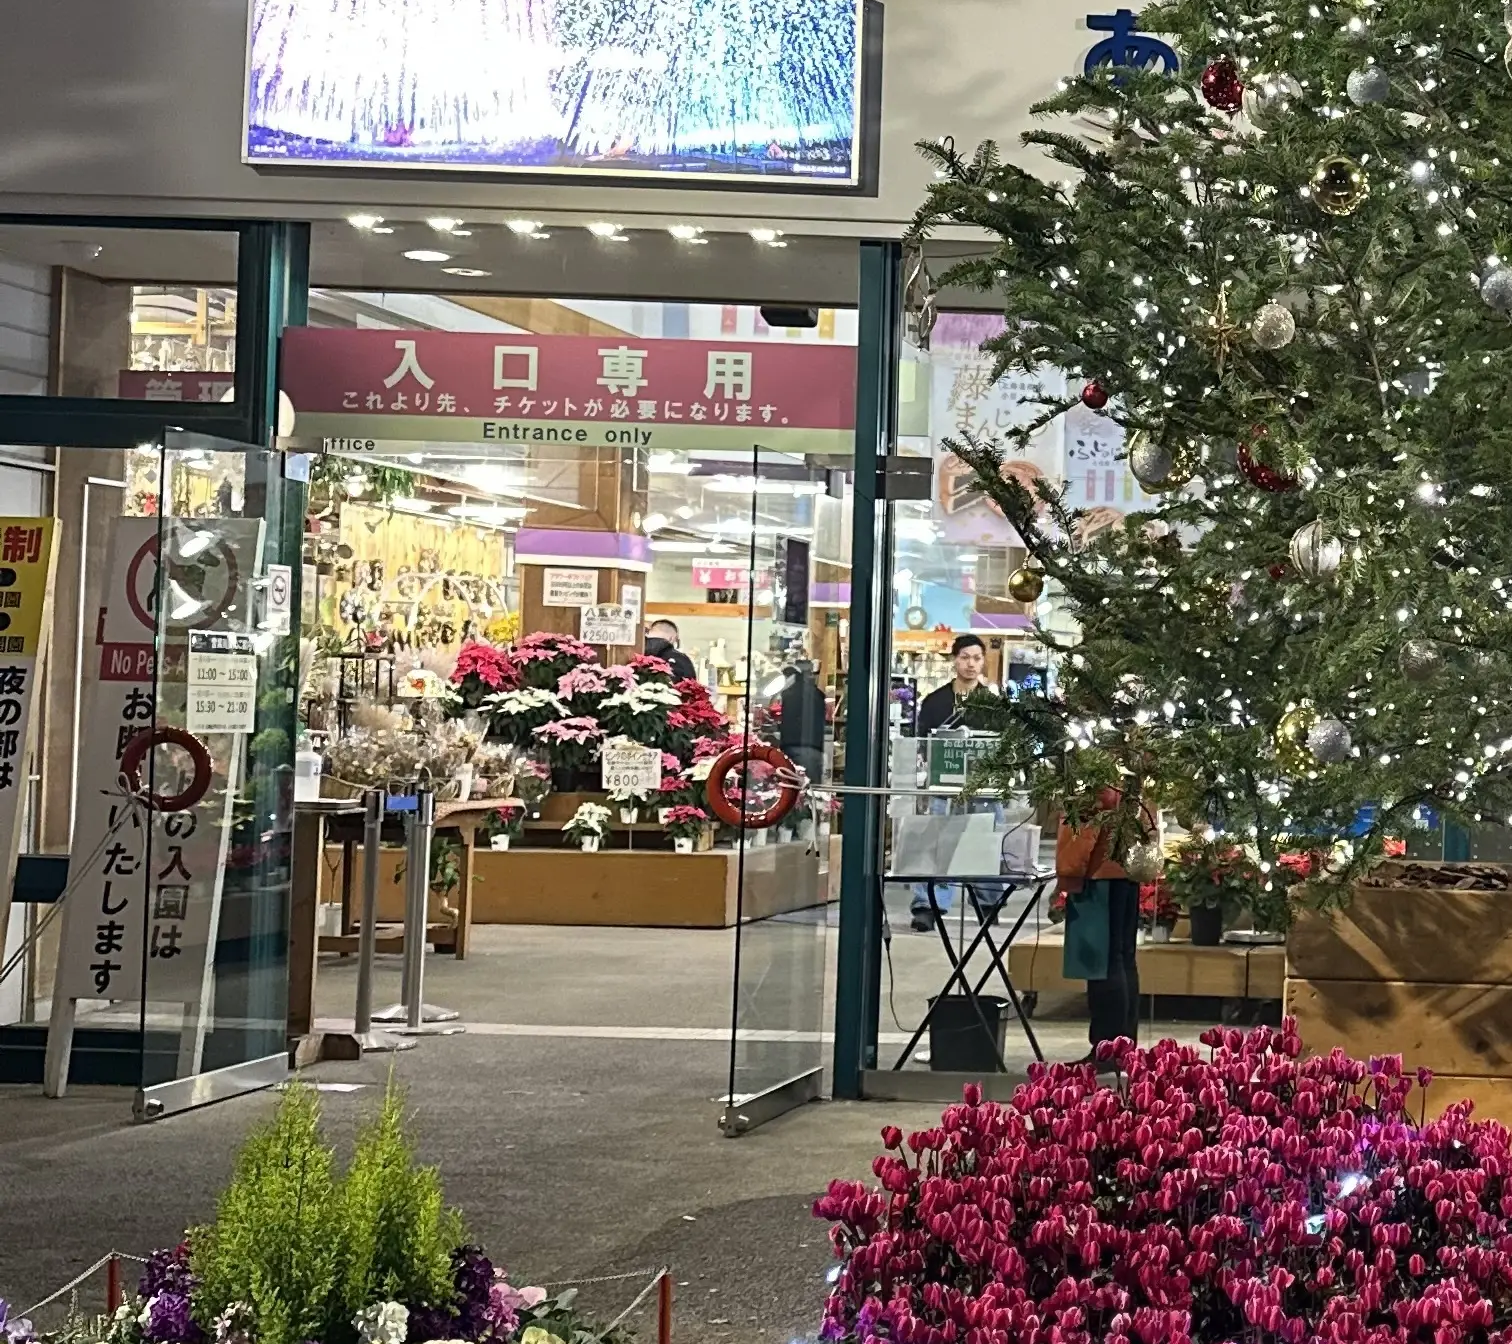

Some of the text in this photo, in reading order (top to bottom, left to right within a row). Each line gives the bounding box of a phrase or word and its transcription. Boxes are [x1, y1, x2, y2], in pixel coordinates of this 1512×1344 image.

[383, 339, 753, 402] 入口専用
[342, 391, 789, 424] これより先、チケットが必要になります。
[326, 437, 376, 451] ffice
[482, 422, 653, 446] Entrance only
[110, 649, 132, 675] No
[136, 650, 170, 676] Pes
[604, 774, 640, 787] ¥800
